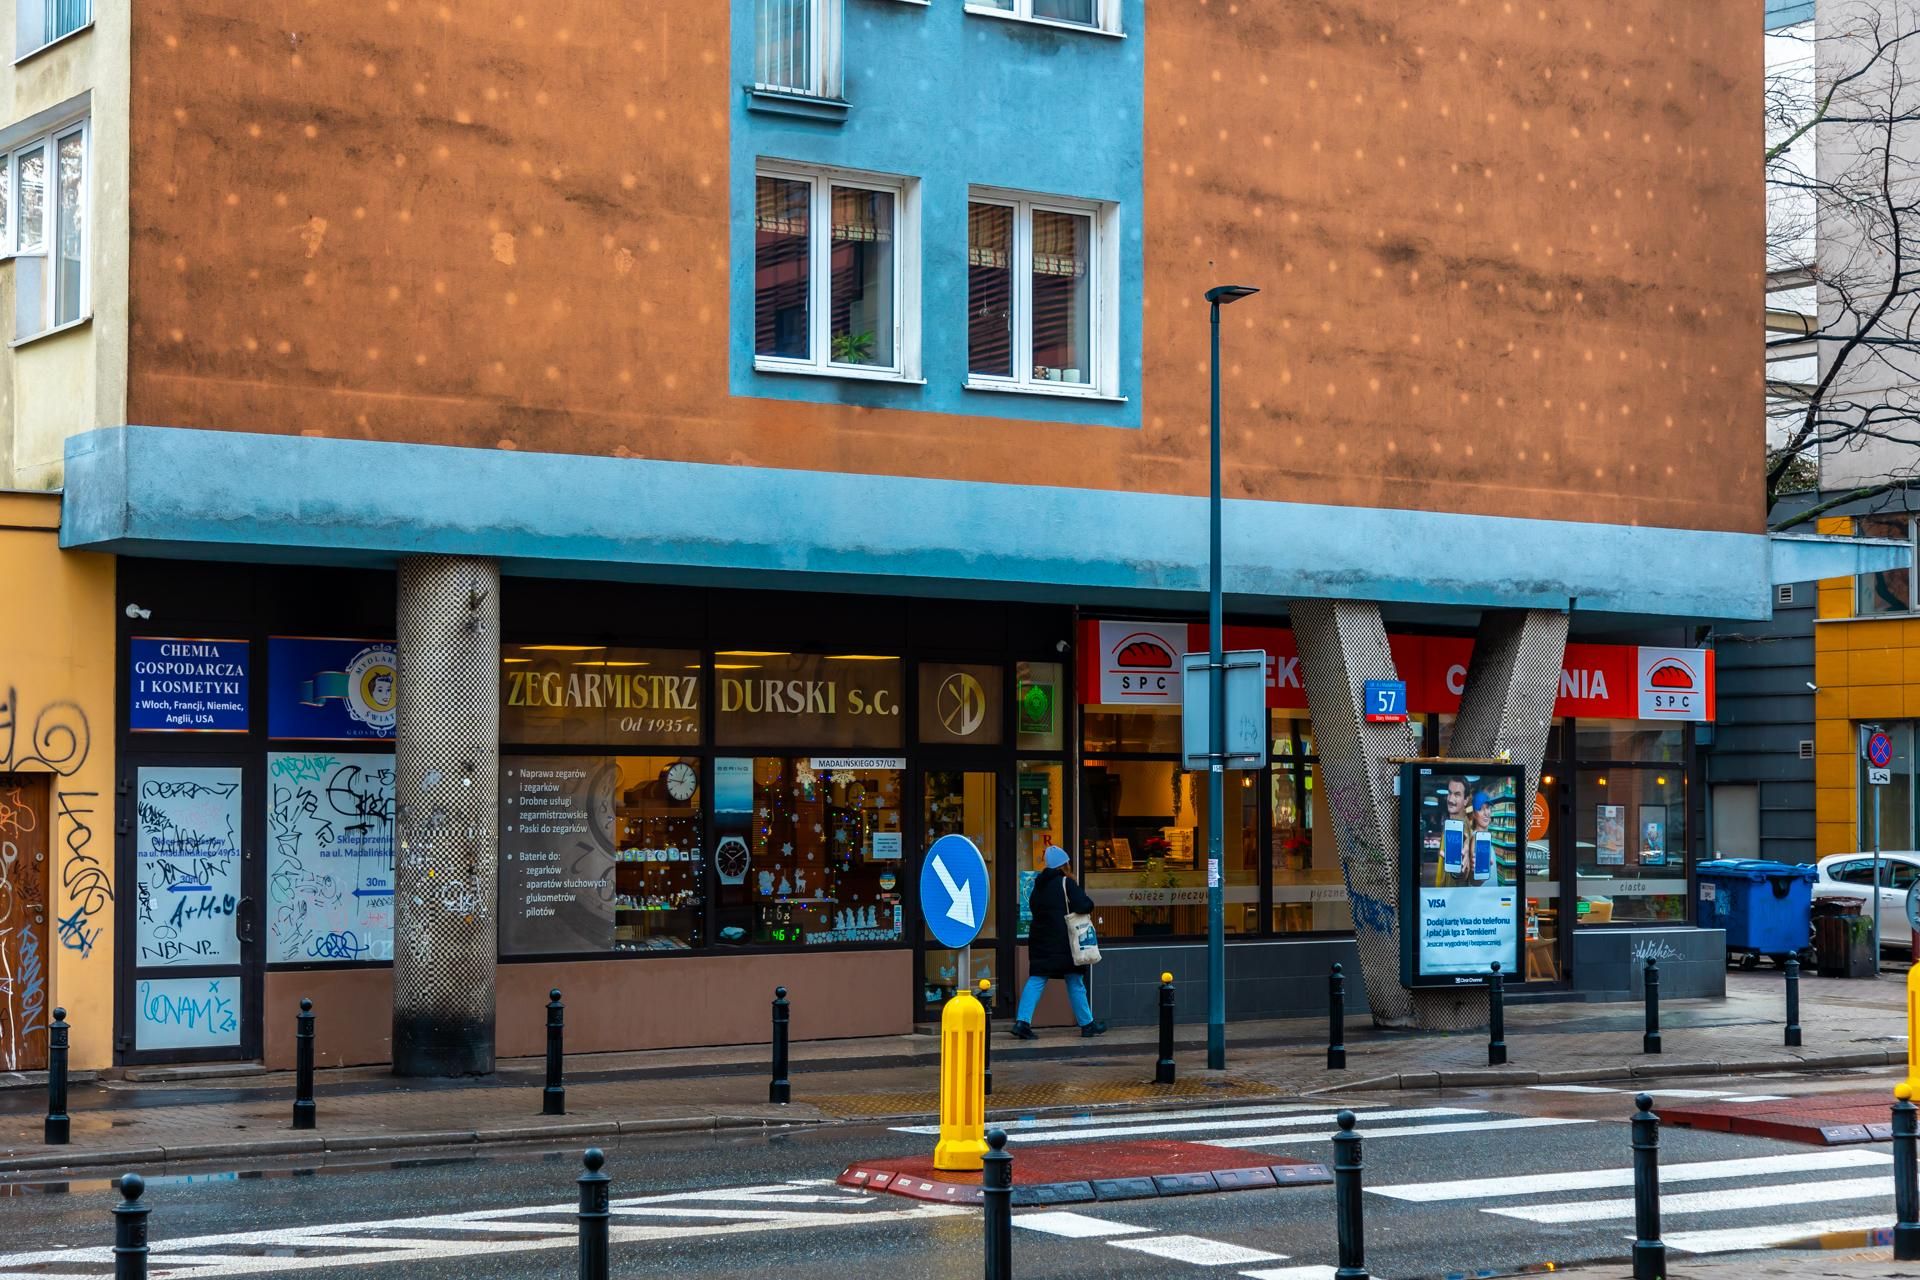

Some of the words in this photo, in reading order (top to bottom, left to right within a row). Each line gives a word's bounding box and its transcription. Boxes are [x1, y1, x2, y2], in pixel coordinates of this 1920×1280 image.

[160, 643, 220, 658] CHEMIA
[135, 661, 244, 677] GOSPODARCZA
[140, 680, 145, 693] I
[151, 680, 240, 695] KOSMETYKI
[507, 671, 697, 710] ZEGARMISTRZ
[721, 678, 837, 714] DURSKI
[135, 701, 140, 709] z
[141, 699, 172, 711] Włoch,
[174, 700, 205, 712] Francji,
[207, 701, 244, 712] Niemiec,
[1378, 690, 1396, 712] 57
[165, 714, 194, 725] Anglii,
[195, 714, 214, 724] USA
[620, 716, 643, 732] Od
[647, 719, 683, 733] 1935
[686, 722, 698, 732] r.
[818, 758, 875, 768] MADALIŃSKIEGO
[520, 769, 554, 780] Naprawa
[555, 769, 587, 780] zegarów
[524, 783, 560, 794] zegarków
[520, 796, 548, 806] Drobne
[549, 796, 572, 808] usługi
[520, 810, 588, 821] zegarmistrzowskie
[520, 824, 539, 833] Paski
[541, 824, 551, 833] do
[552, 824, 588, 835] zegarków
[337, 835, 361, 845] Sklep
[320, 849, 331, 858] na
[332, 847, 343, 858] ul.
[520, 852, 546, 861] Baterie
[548, 852, 561, 861] do:
[526, 866, 562, 876] zegarków
[366, 877, 386, 887] 30m
[526, 880, 562, 890] aparatów
[563, 878, 607, 889] słuchowych
[1620, 882, 1646, 892] ciasta
[526, 892, 577, 904] glukometrów
[1427, 898, 1446, 908] VISA
[526, 906, 556, 918] pilotów
[1426, 918, 1444, 928] Dodaj
[1444, 918, 1459, 927] kartę
[1460, 917, 1472, 925] Visa
[1473, 917, 1481, 925] do
[1482, 916, 1510, 925] telefonu
[1442, 928, 1450, 938] jak
[1466, 927, 1496, 936] Tomkiem!
